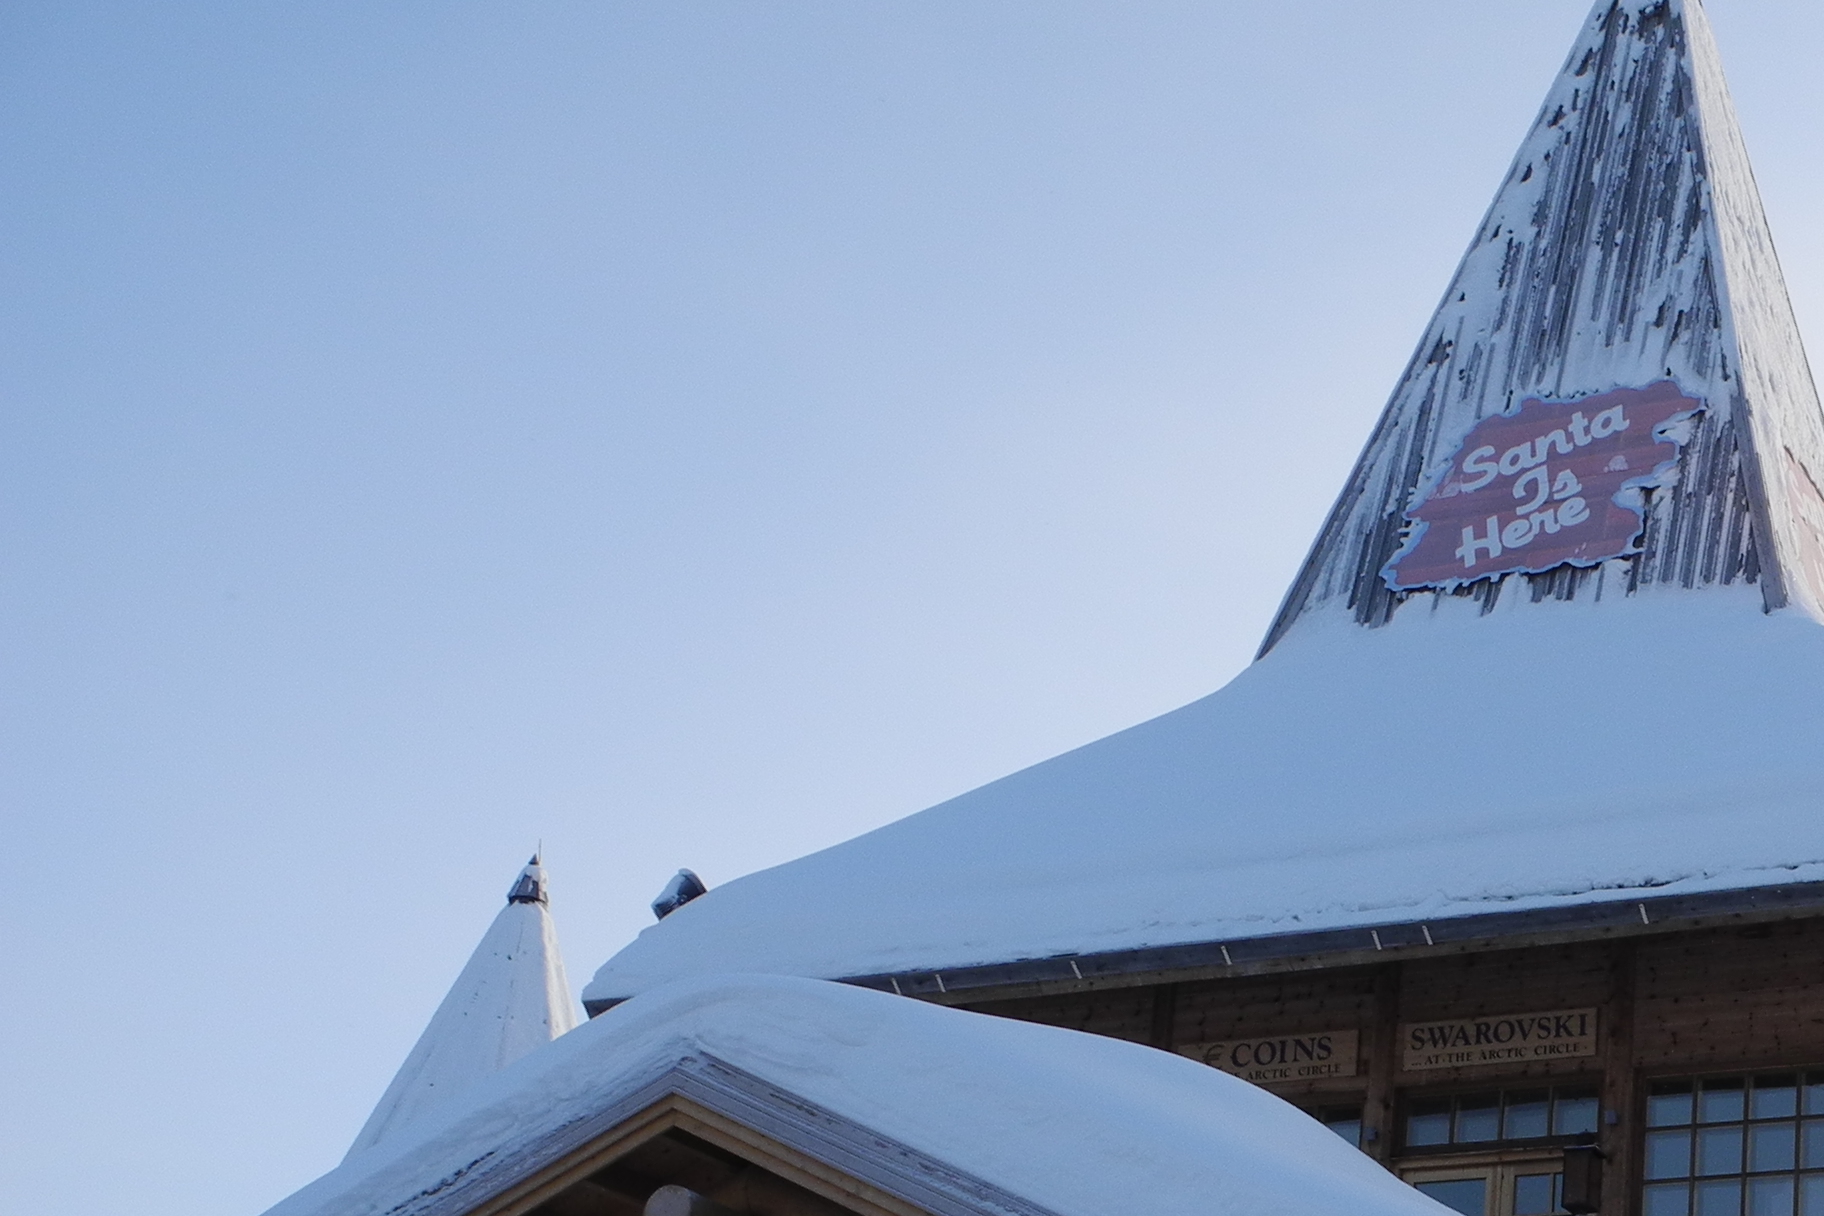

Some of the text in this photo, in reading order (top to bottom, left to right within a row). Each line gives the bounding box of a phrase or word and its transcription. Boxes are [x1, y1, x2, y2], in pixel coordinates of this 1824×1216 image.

[1461, 404, 1630, 493] Santa
[1512, 465, 1583, 516] Is
[1454, 496, 1591, 569] Here
[1411, 1013, 1588, 1051] SWAROVSKI
[1230, 1036, 1332, 1067] COINS
[1447, 1050, 1472, 1063] THE
[1478, 1046, 1528, 1061] ARCTIC
[1534, 1042, 1580, 1056] CIRCLE
[1248, 1067, 1291, 1080] ARCTIC
[1298, 1063, 1341, 1077] CIRCLE
